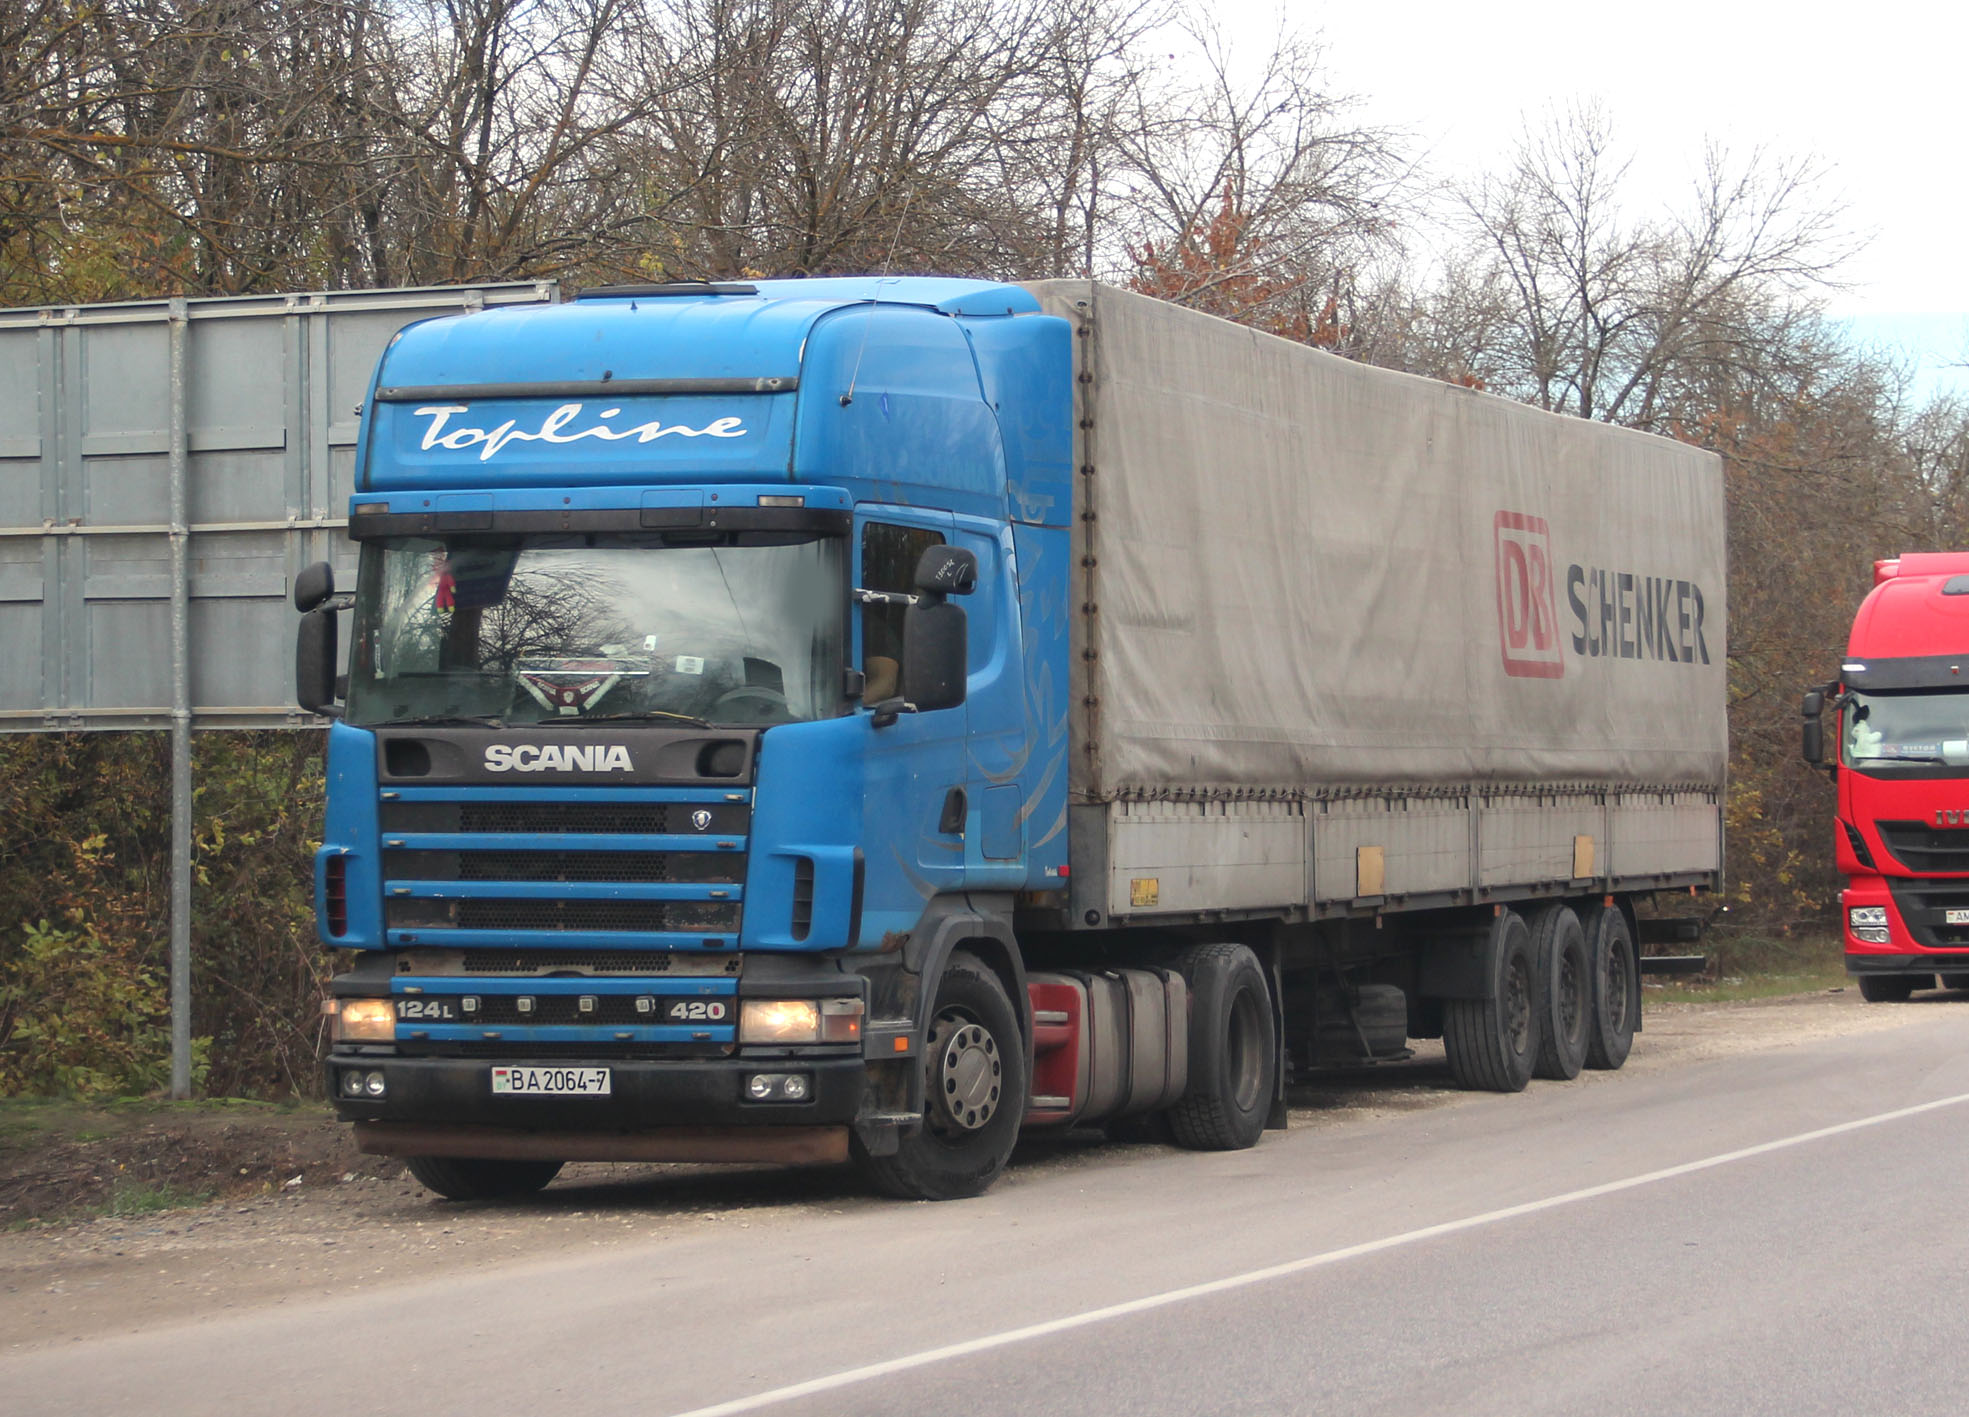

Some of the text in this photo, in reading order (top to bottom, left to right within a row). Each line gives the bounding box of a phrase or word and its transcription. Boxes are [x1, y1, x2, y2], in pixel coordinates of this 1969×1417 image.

[414, 403, 748, 461] Topline
[1501, 537, 1711, 665] DB SCHENKER
[484, 744, 635, 772] SCANIA
[670, 1002, 725, 1020] 420
